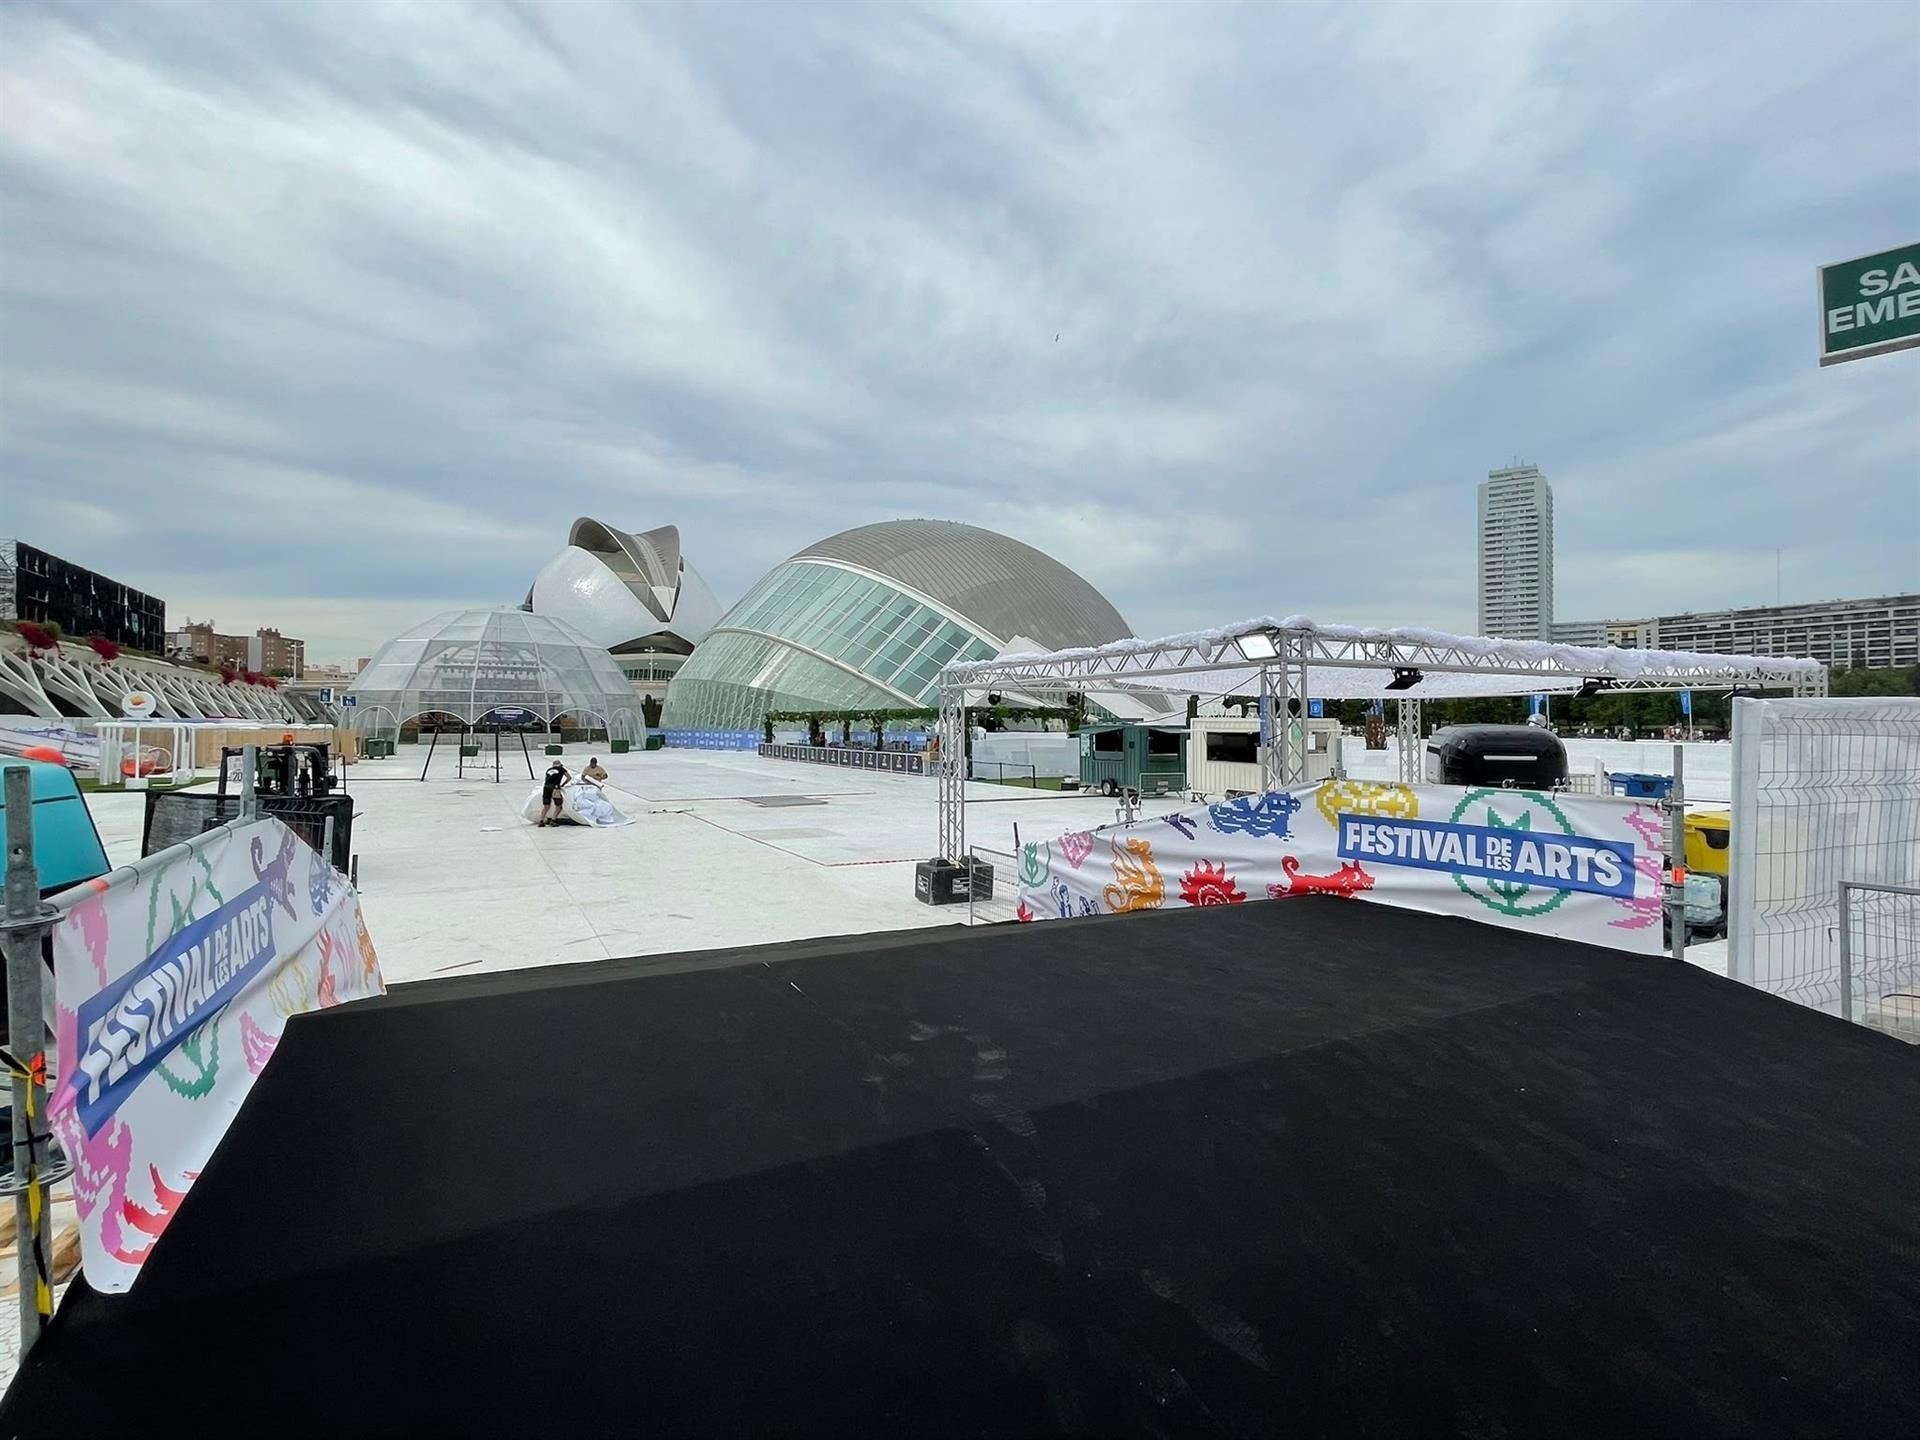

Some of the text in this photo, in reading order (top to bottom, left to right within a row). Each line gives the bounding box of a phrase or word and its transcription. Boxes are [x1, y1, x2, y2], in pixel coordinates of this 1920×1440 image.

[1859, 261, 1920, 296] SA
[1828, 289, 1920, 334] EME
[1345, 821, 1623, 888] FESTIVAL DE LES ARTS
[80, 935, 216, 1105] FESTIVAL
[215, 923, 229, 965] DE
[230, 895, 270, 978] ARTS
